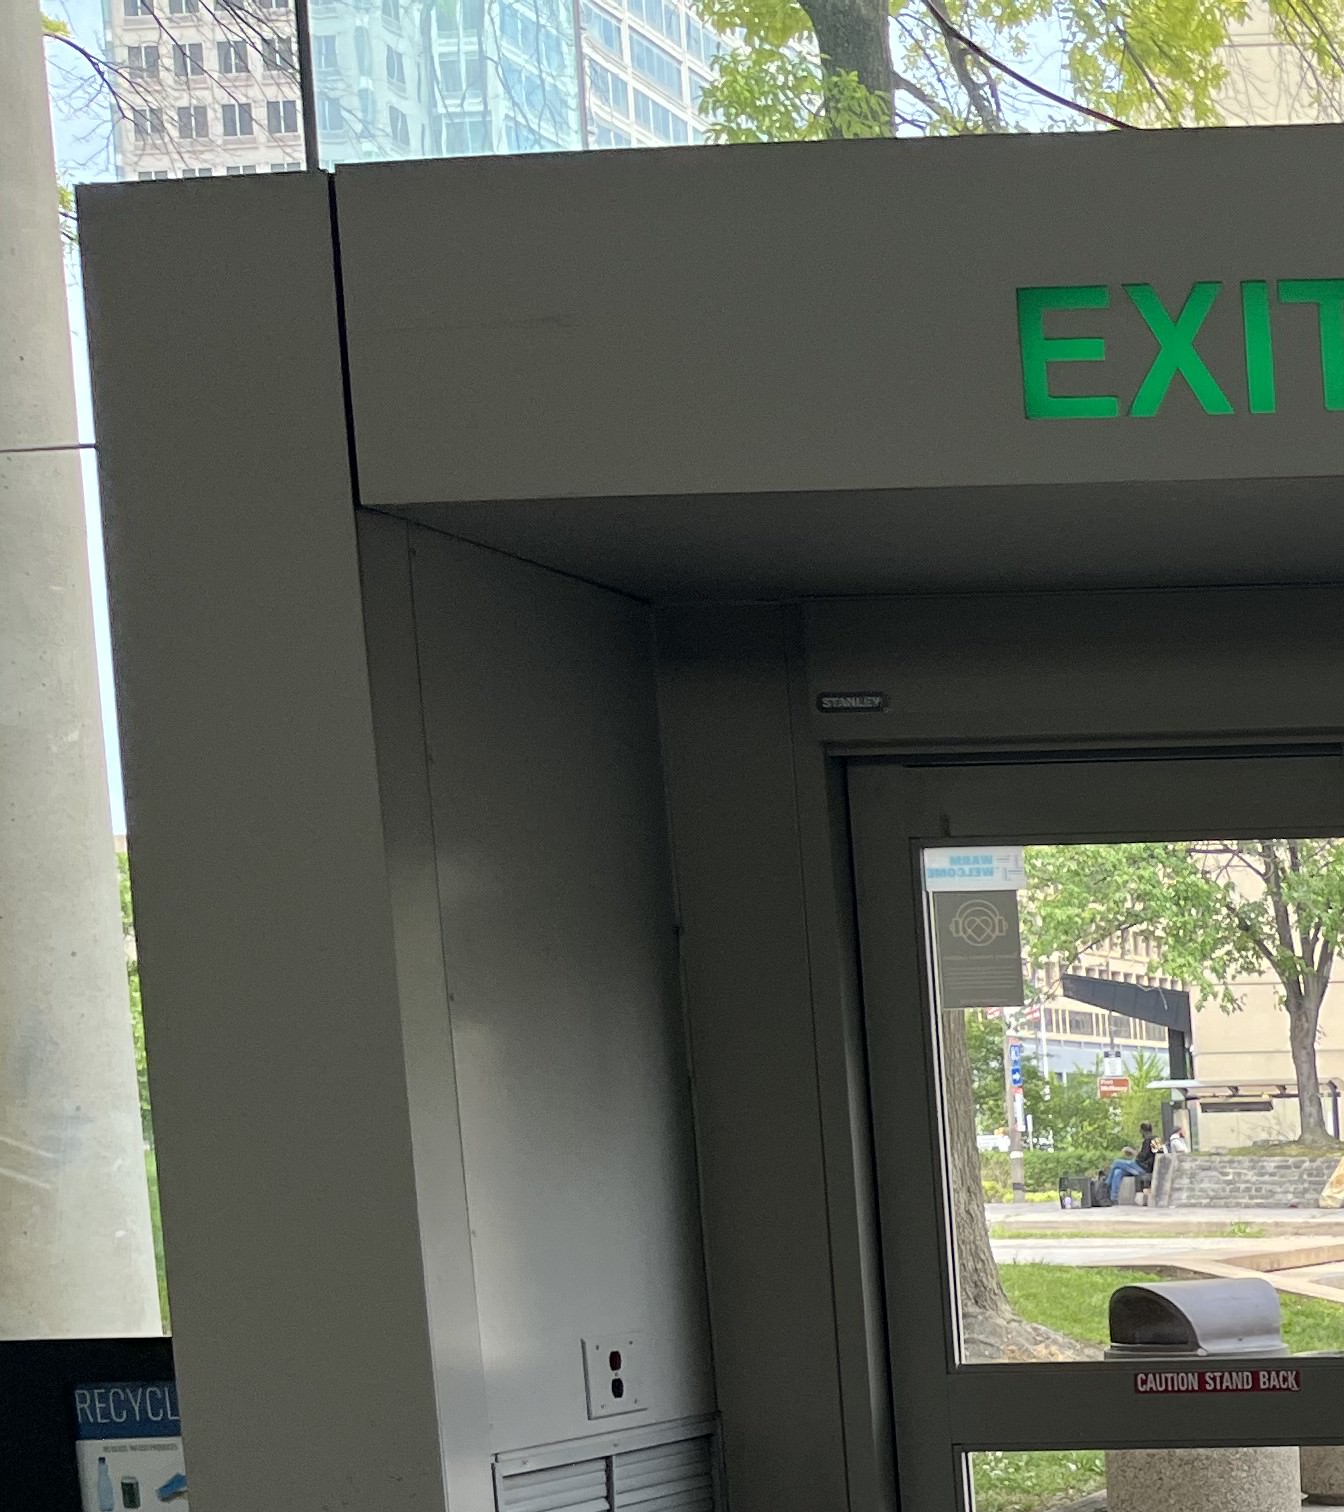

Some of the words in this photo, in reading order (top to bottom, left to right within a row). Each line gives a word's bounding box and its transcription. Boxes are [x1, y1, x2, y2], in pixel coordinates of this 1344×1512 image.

[822, 696, 880, 708] STANLEY
[1137, 1373, 1199, 1392] CAUTION
[1205, 1371, 1253, 1390] STAND
[1259, 1370, 1299, 1391] BACK
